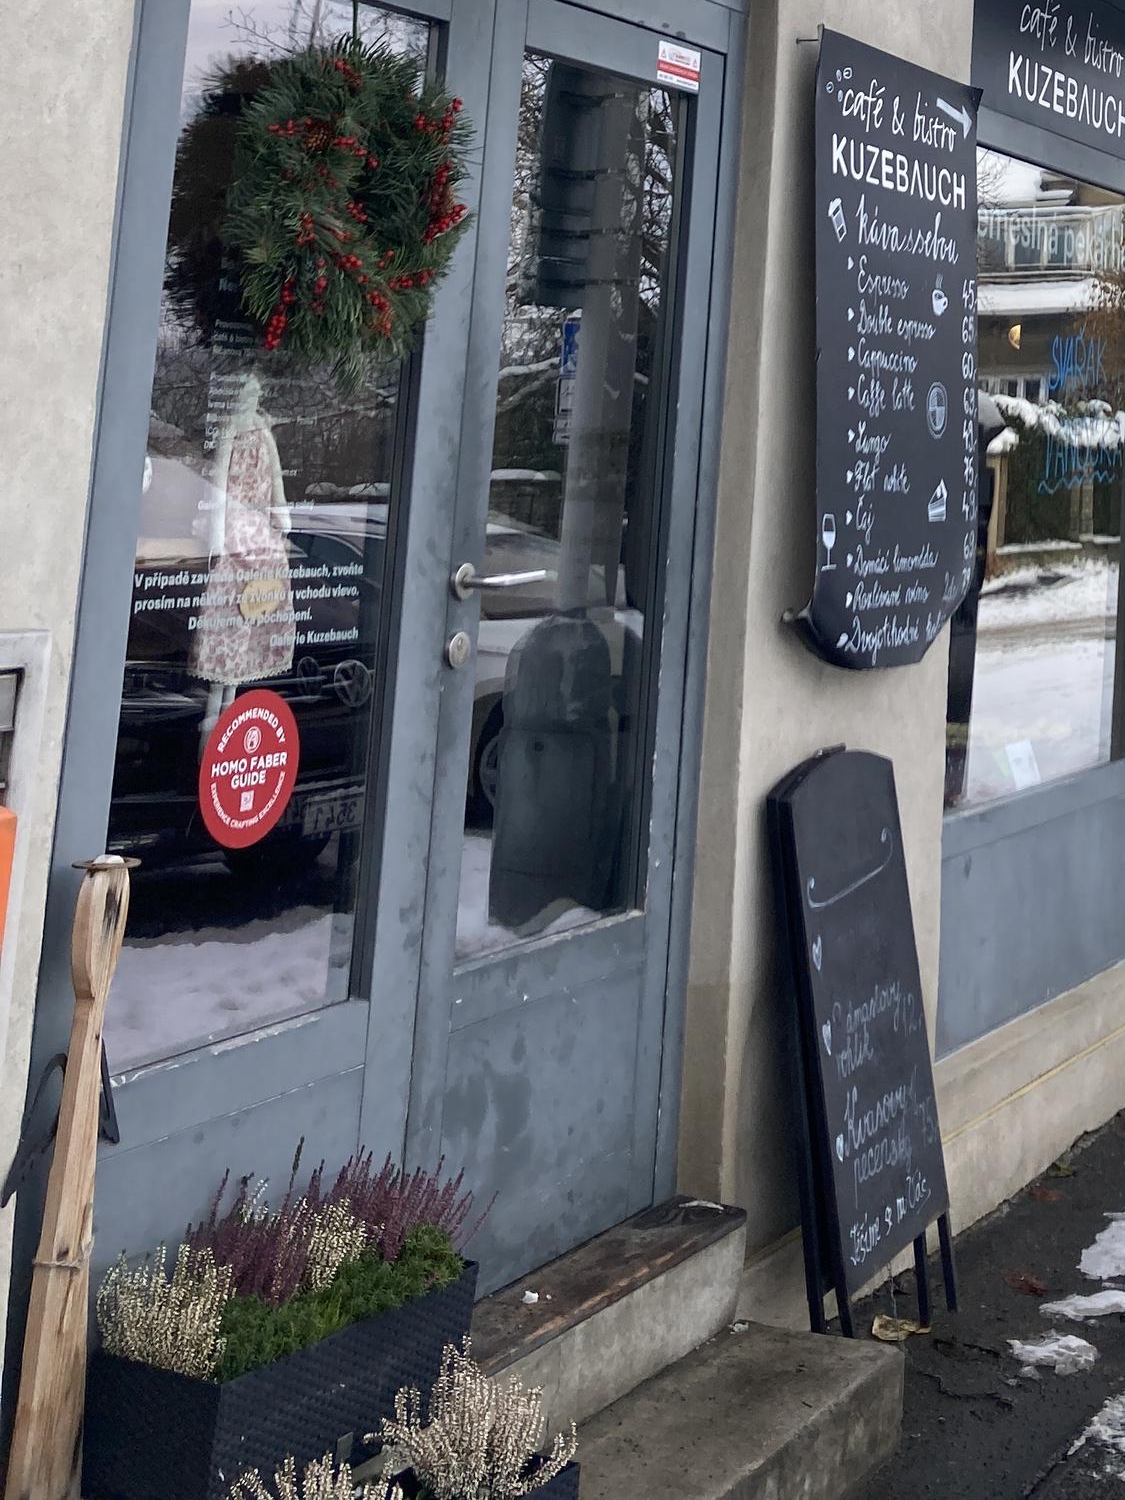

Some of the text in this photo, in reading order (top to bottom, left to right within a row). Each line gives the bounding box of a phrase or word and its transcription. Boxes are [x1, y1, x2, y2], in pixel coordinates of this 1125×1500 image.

[1065, 15, 1077, 57] &
[1084, 12, 1124, 78] bistro
[842, 79, 957, 152] café & bistro
[832, 133, 966, 210] KUZEBAUCH
[857, 255, 909, 306] Espresso
[857, 299, 893, 336] Double
[897, 318, 936, 346] espresso
[857, 337, 918, 378] Cappuccino
[892, 377, 915, 412] latte
[854, 460, 880, 492] Flat
[856, 494, 875, 545] Čaj
[134, 595, 175, 614] prosím
[176, 596, 191, 608] na
[295, 584, 331, 600] vchodu
[135, 573, 144, 588] V
[144, 571, 190, 590] případě
[306, 626, 359, 643] Kuzebauch
[217, 707, 287, 753] RECOMMENDED BY
[211, 751, 288, 778] HOMO FABER
[231, 770, 267, 790] GUIDE
[230, 815, 259, 830] CRAFTING
